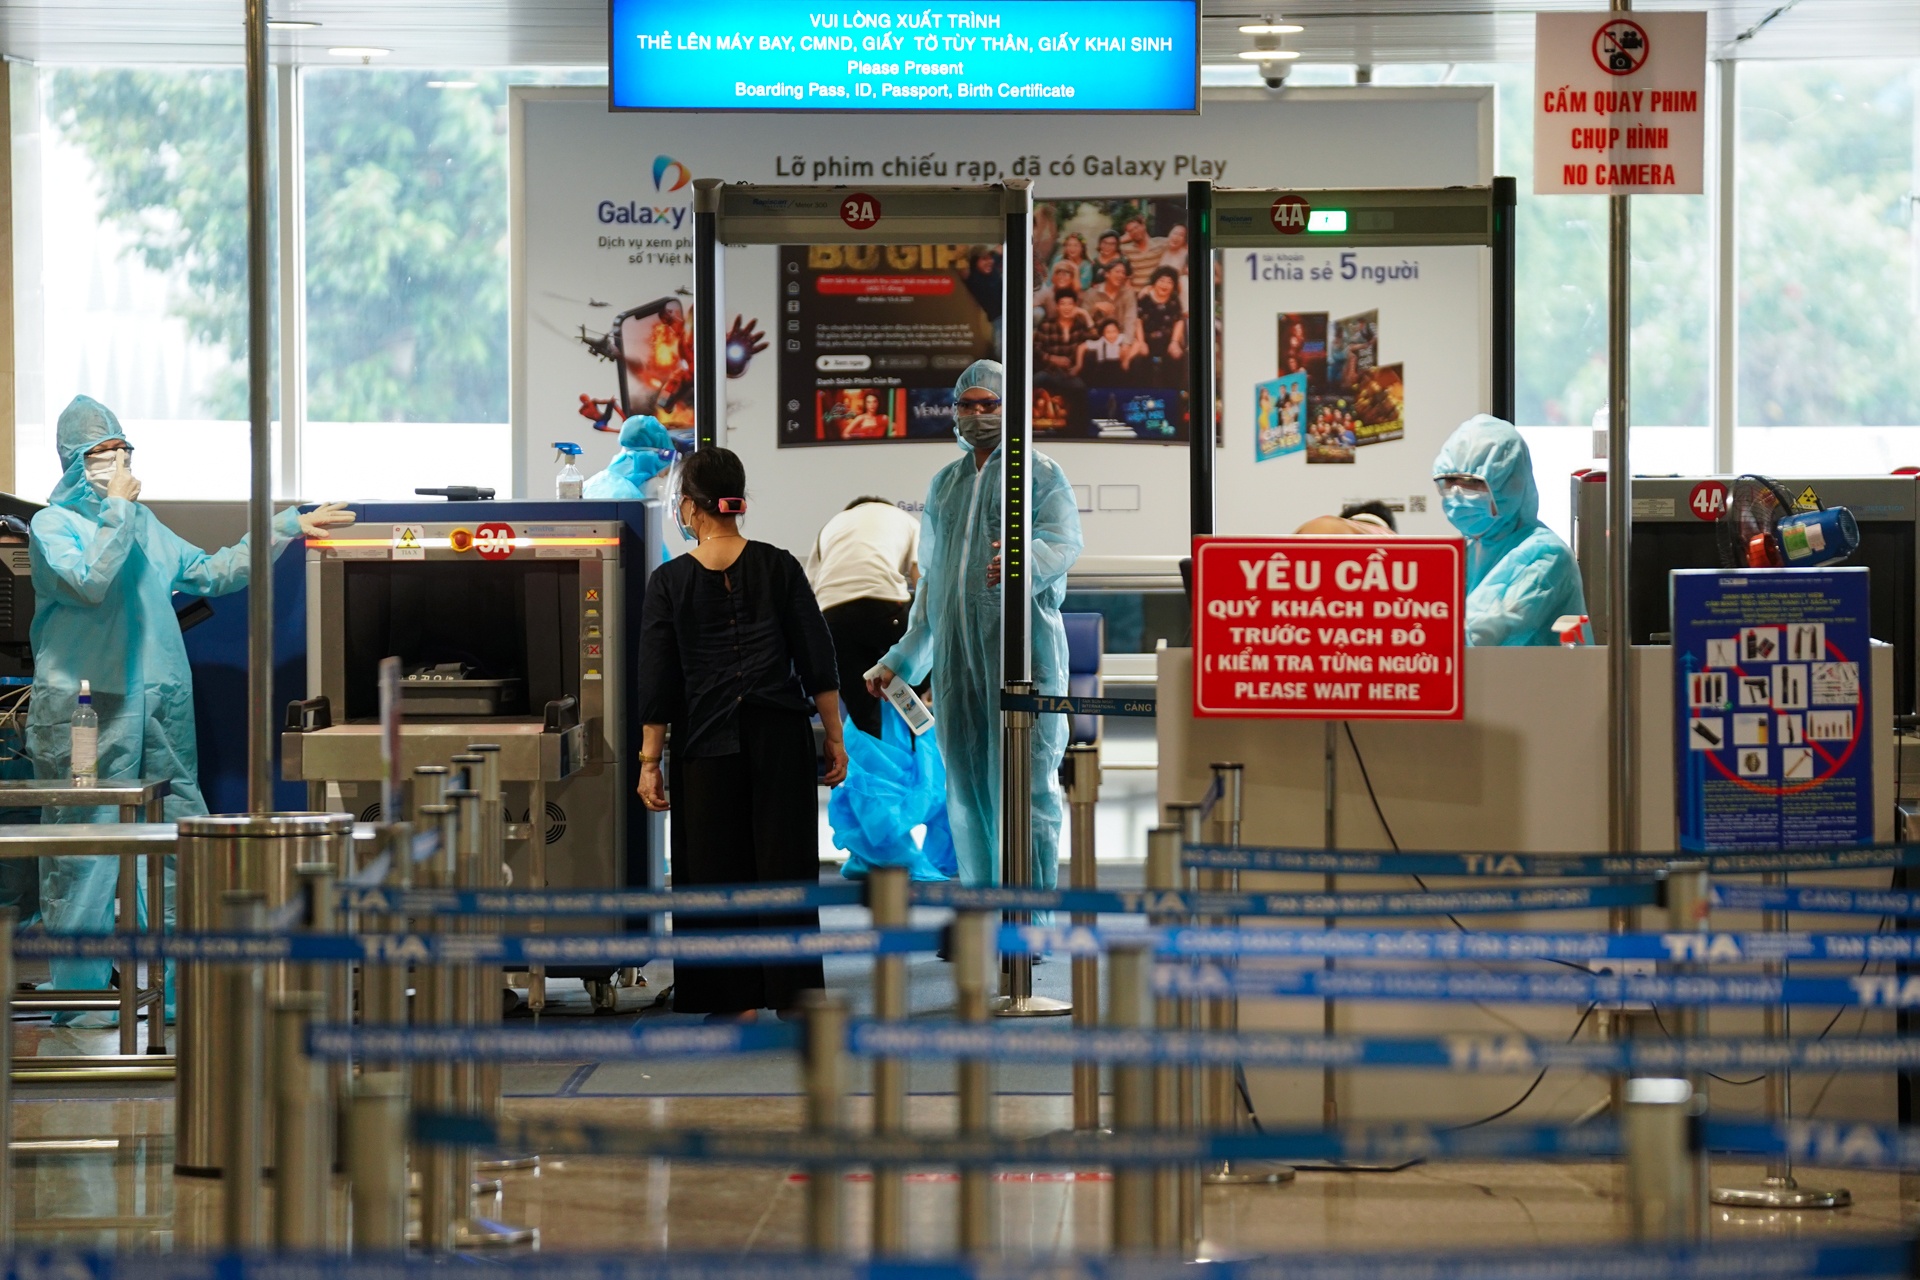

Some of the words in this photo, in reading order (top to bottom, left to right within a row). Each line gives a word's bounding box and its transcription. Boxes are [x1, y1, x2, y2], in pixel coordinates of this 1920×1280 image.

[810, 13, 840, 28] VUI
[842, 8, 891, 28] LÒNG
[896, 8, 944, 28] XUẤT
[947, 8, 1000, 28] TRÌNH
[637, 31, 672, 50] THẺ
[677, 33, 713, 50] LÊN
[716, 33, 756, 51] MÁY
[760, 36, 796, 53] BAY,
[799, 36, 857, 53] CMND,
[862, 32, 902, 51] GIẤY
[914, 35, 940, 51] TỜ
[942, 33, 976, 51] TÙY
[982, 35, 1034, 53] THÂN,
[1038, 32, 1080, 51] GIẤY
[1085, 37, 1126, 51] KHAI
[1131, 37, 1173, 51] SINH
[848, 61, 900, 75] Please
[905, 61, 963, 75] Present
[735, 83, 803, 100] Boarding
[808, 83, 850, 100] Pass,
[855, 83, 877, 100] ID,
[882, 83, 952, 100] Passport,
[957, 83, 994, 98] Birth
[997, 83, 1075, 98] Certificate
[1544, 85, 1587, 112] CẤM
[1594, 91, 1643, 116] QUAY
[1651, 91, 1697, 112] PHIM
[1571, 128, 1619, 153] CHỤP
[1626, 123, 1668, 148] HÌNH
[776, 154, 805, 177] Lỡ
[813, 156, 874, 181] phim
[883, 153, 947, 177] chiếu
[957, 159, 1004, 182] rạp,
[1012, 155, 1041, 177] đã
[1050, 156, 1075, 177] có
[1084, 156, 1166, 180] Galaxy
[1175, 156, 1227, 181] Play
[1564, 164, 1588, 185] NO
[1596, 164, 1675, 185] CAMERA
[597, 200, 686, 230] Galaxy
[845, 201, 875, 222] 3A
[1219, 215, 1253, 223] Rapiscan
[1274, 203, 1305, 227] 4A
[598, 235, 625, 250] Dịch
[629, 238, 643, 250] vụ
[646, 238, 672, 248] xem
[675, 235, 694, 251] phi
[629, 251, 643, 264] số
[647, 253, 653, 264] 1
[657, 253, 681, 264] Việt
[1246, 253, 1258, 281] 1
[1263, 262, 1304, 280] chia
[1310, 261, 1334, 280] sẻ
[1340, 253, 1357, 280] 5
[1361, 262, 1420, 283] người
[897, 500, 925, 512] Gala
[1693, 488, 1725, 513] 4A
[479, 528, 510, 554] 3A
[1238, 552, 1321, 591] YÊU
[1334, 548, 1418, 591] CẦU
[1207, 596, 1261, 620] QUÝ
[1271, 597, 1364, 618] KHÁCH
[1373, 597, 1449, 619] DỪNG
[1229, 624, 1311, 646] TRƯỚC
[1318, 628, 1384, 649] VẠCH
[1390, 623, 1426, 646] ĐỎ
[1218, 646, 1270, 672] KIỂM
[1274, 655, 1315, 672] TRA
[1319, 652, 1373, 673] TỪNG
[1378, 652, 1439, 674] NGƯỜI
[1234, 682, 1307, 699] PLEASE
[1314, 683, 1362, 700] WAIT
[1368, 683, 1421, 700] HERE
[1033, 697, 1075, 712] TIA
[1124, 701, 1152, 712] CẢNG
[1459, 854, 1524, 874] TIA
[1119, 892, 1187, 912] TIA
[359, 934, 429, 959] TIA
[1022, 925, 1100, 952] TIA
[1660, 932, 1743, 959] TIA
